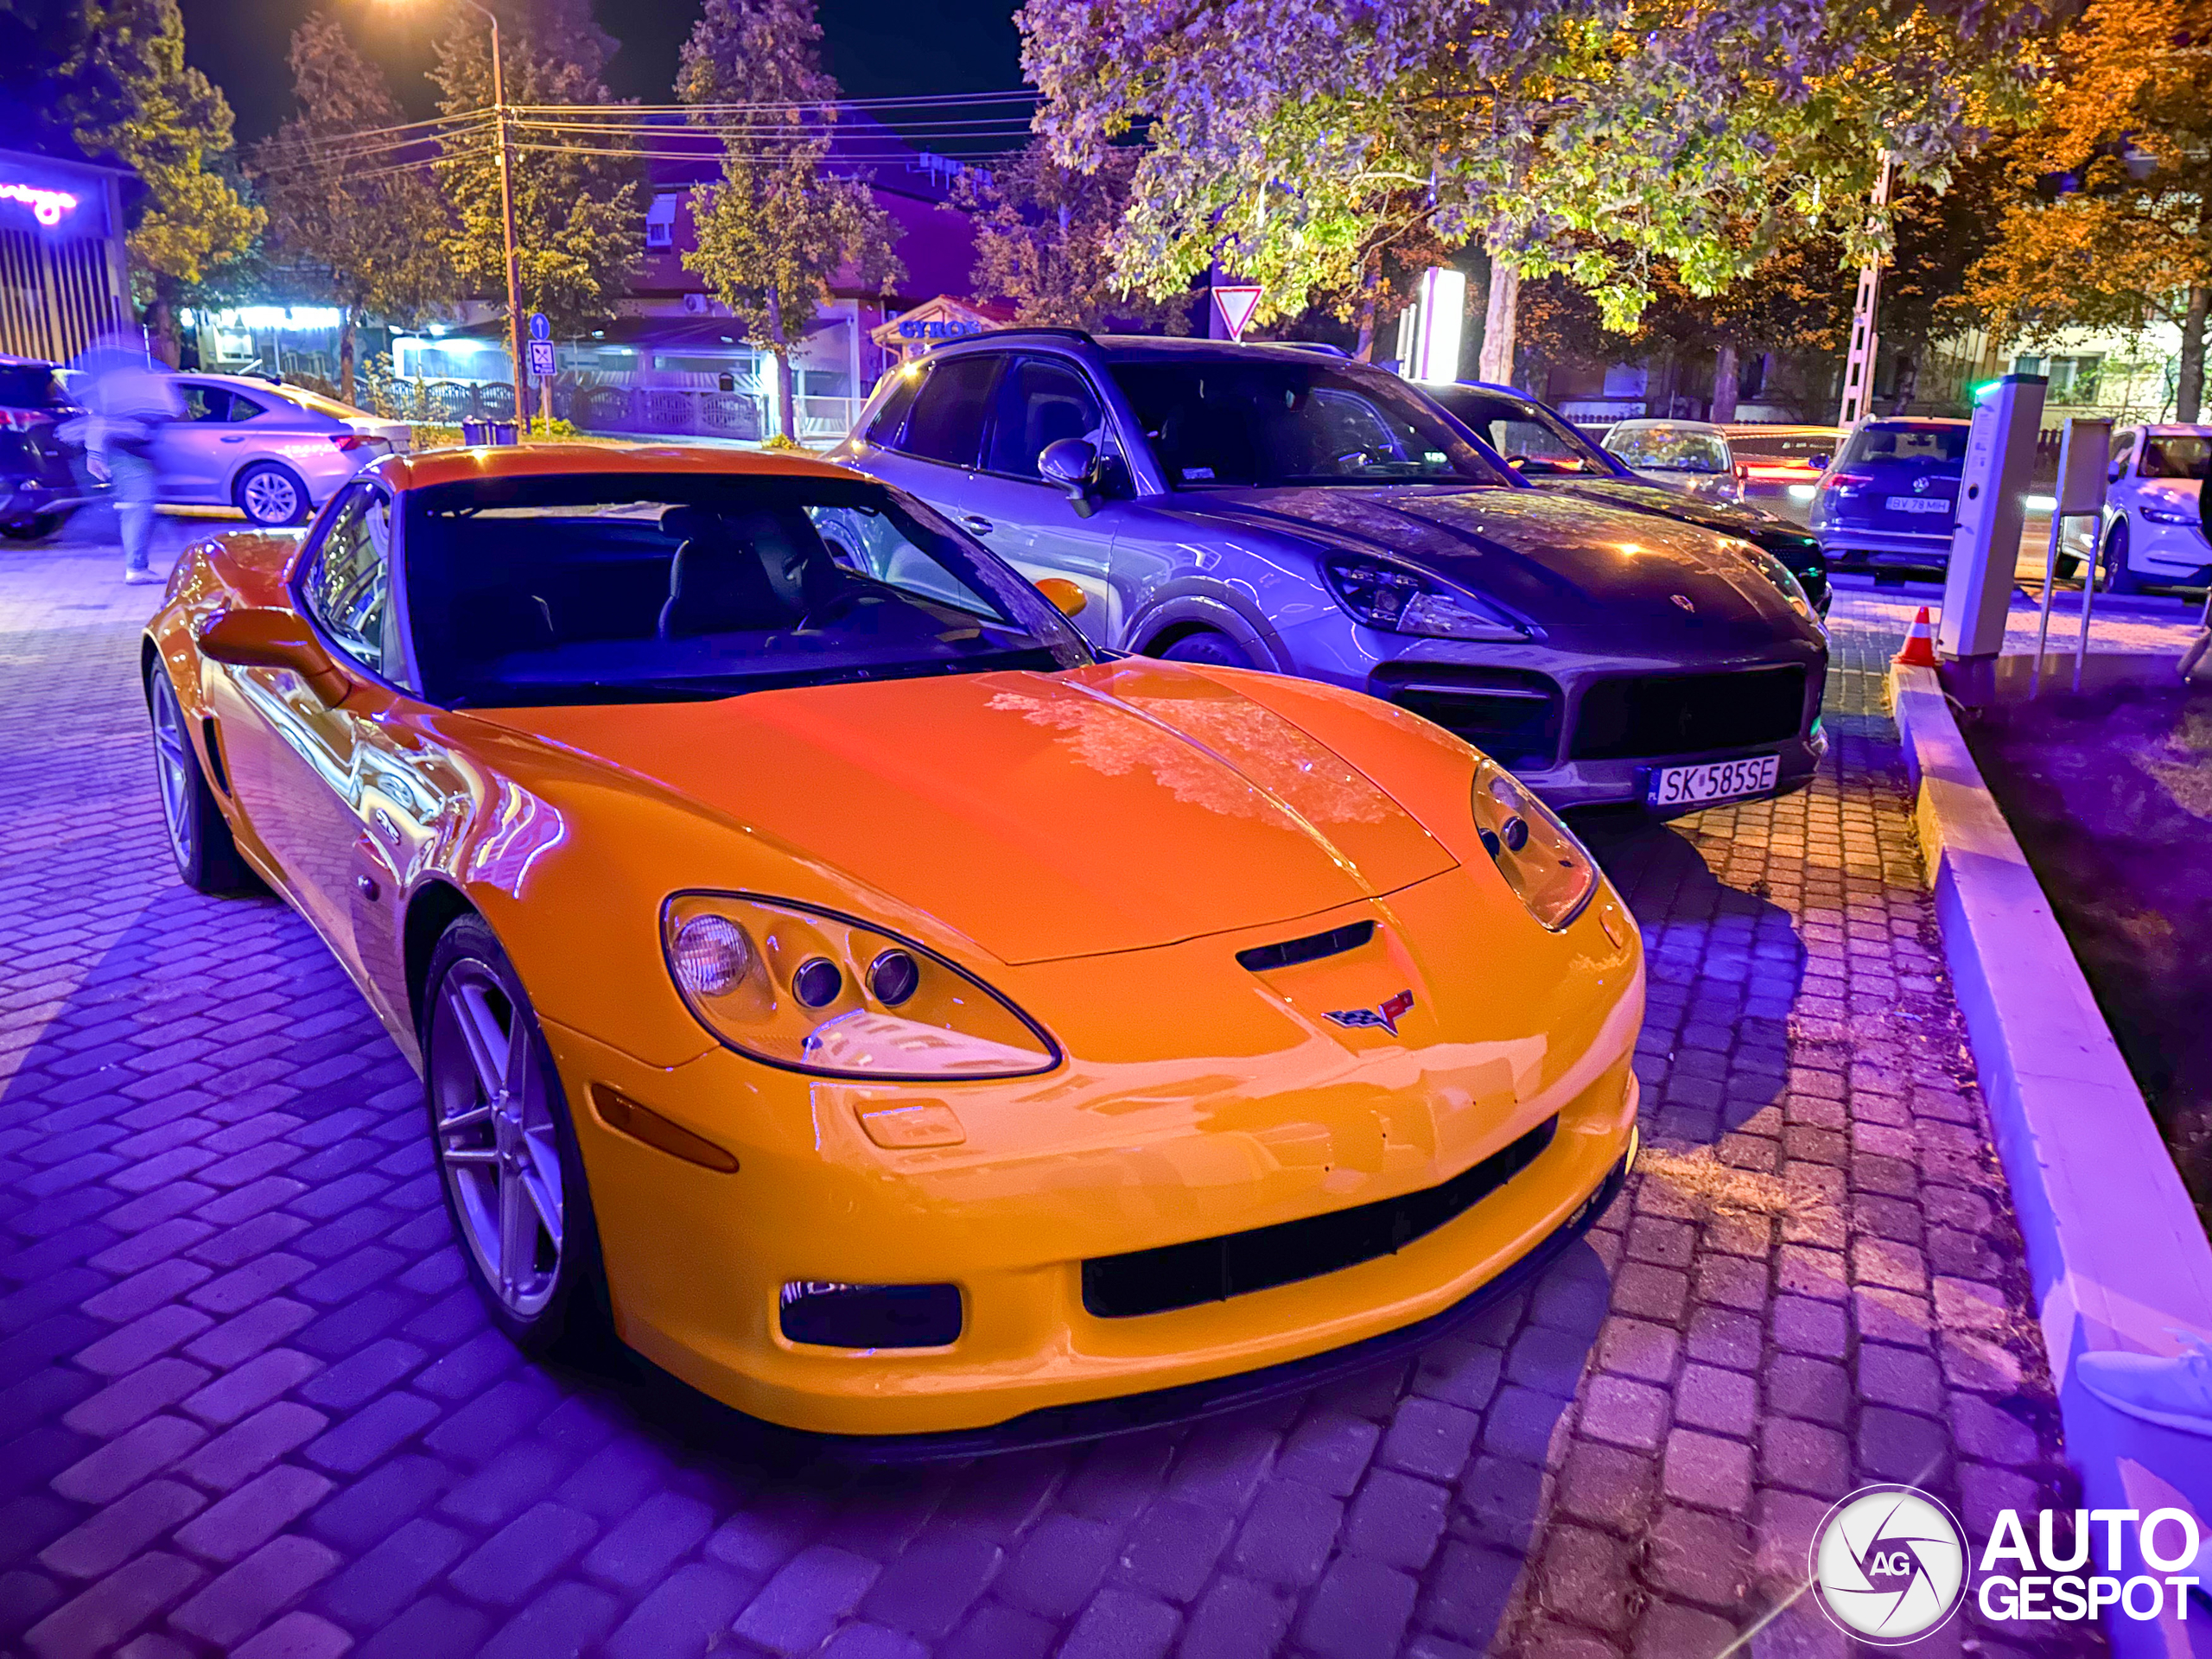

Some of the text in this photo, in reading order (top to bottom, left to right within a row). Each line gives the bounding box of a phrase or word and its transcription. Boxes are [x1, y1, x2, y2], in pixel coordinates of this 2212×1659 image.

[899, 321, 982, 339] GYROS
[1892, 499, 1909, 508] BV
[1911, 499, 1925, 510] 78
[1664, 759, 1775, 801] SK 585SE
[1647, 791, 1657, 801] PL
